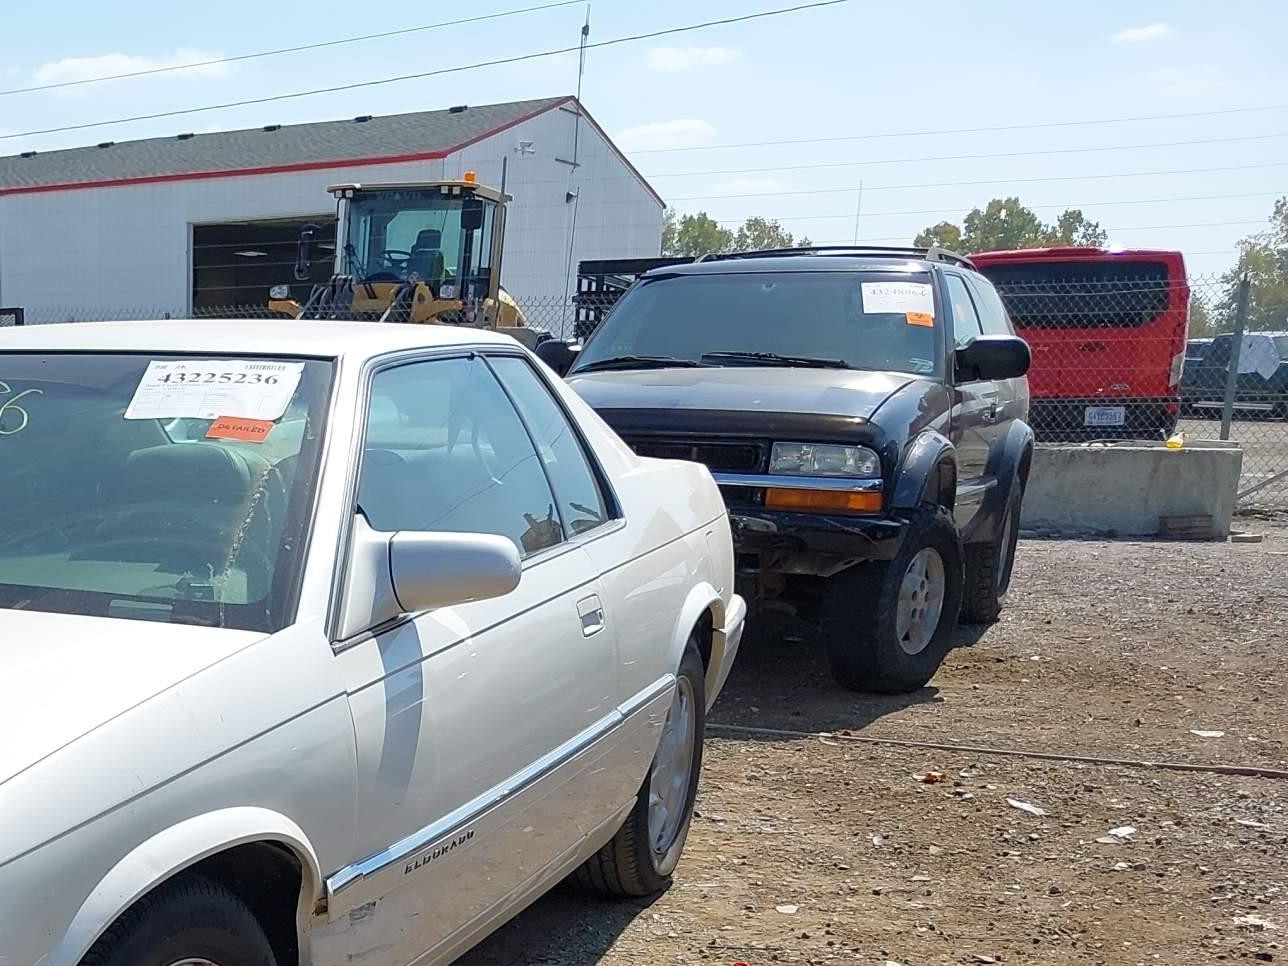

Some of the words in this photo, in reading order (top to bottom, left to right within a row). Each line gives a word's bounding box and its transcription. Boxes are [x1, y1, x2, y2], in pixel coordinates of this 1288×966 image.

[157, 371, 279, 385] 43225236
[217, 422, 266, 435] DETAILED
[404, 829, 475, 875] ELDORADO
